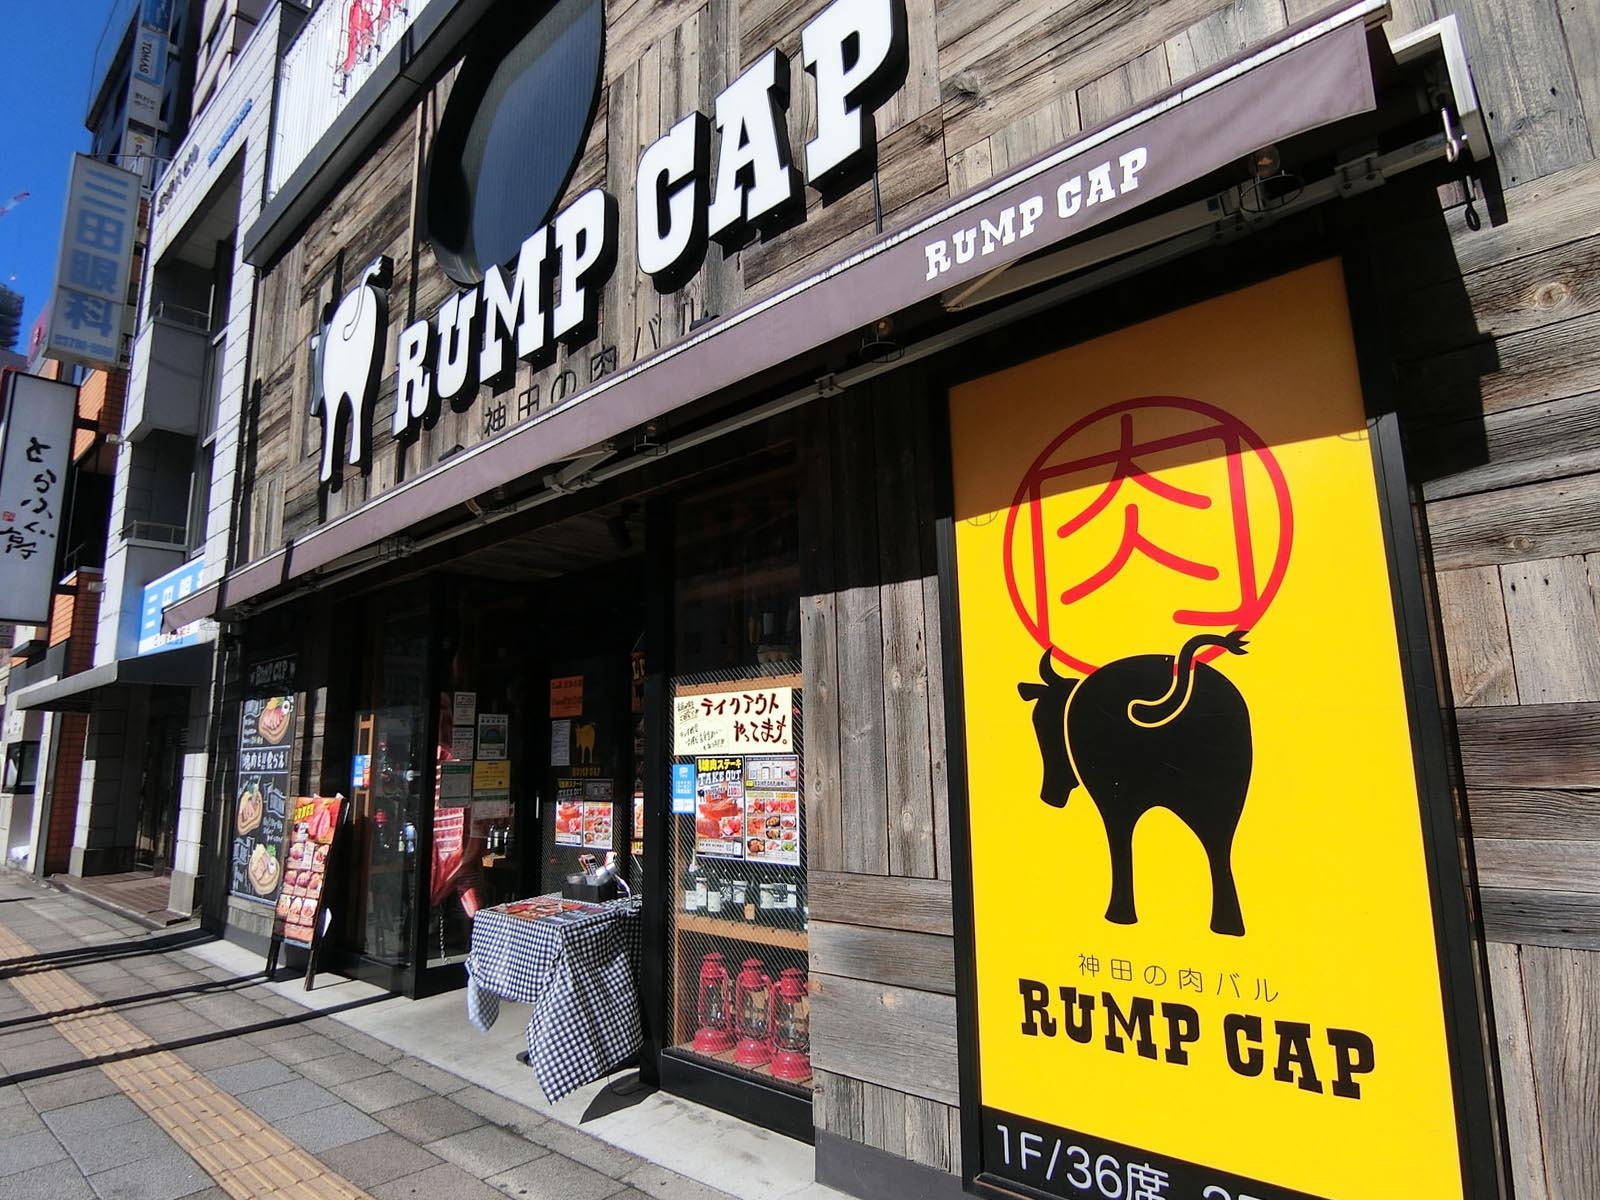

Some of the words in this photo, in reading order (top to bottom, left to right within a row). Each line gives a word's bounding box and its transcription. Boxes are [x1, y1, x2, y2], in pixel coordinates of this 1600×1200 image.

[64, 169, 129, 338] 三田眼科
[391, 187, 608, 437] RUMP
[635, 0, 897, 276] CAP
[924, 195, 1044, 281] RUMP
[1056, 147, 1148, 219] CAP
[1029, 413, 1259, 645] 肉
[700, 693, 779, 716] テイクアウト
[733, 714, 788, 745] やってます。
[697, 771, 724, 787] TAKE
[725, 769, 742, 782] OUT
[1078, 952, 1280, 1004] 神田の肉バル
[1018, 978, 1201, 1067] RUMP
[1223, 1012, 1376, 1100] CAP
[996, 1124, 1170, 1200] 1F/36席
